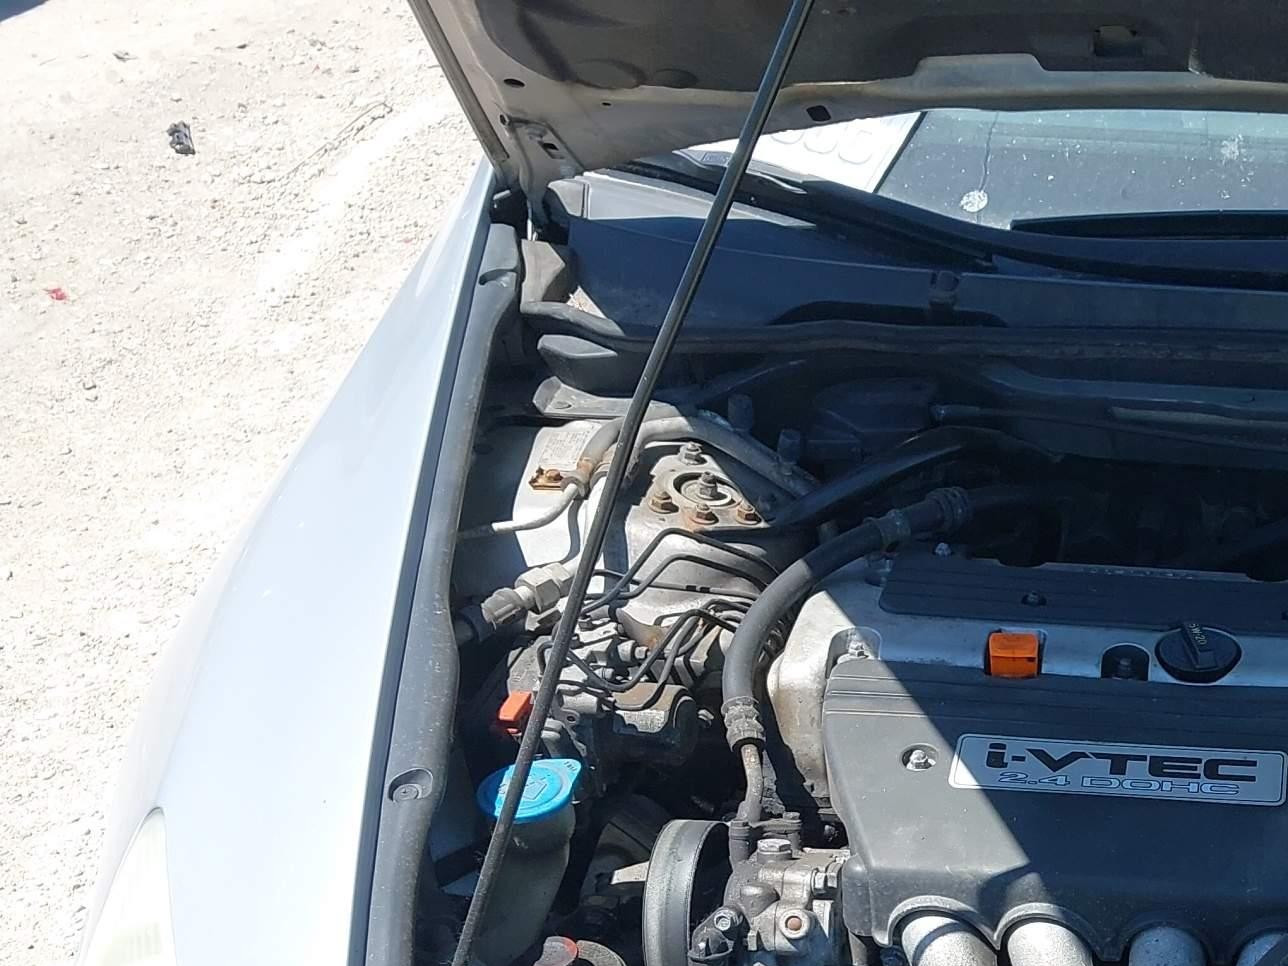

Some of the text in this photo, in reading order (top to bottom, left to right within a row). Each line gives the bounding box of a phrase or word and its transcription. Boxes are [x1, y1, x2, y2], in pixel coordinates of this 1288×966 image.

[985, 742, 1258, 783] i-VTEC
[998, 771, 1239, 796] 2.4 DOHC
